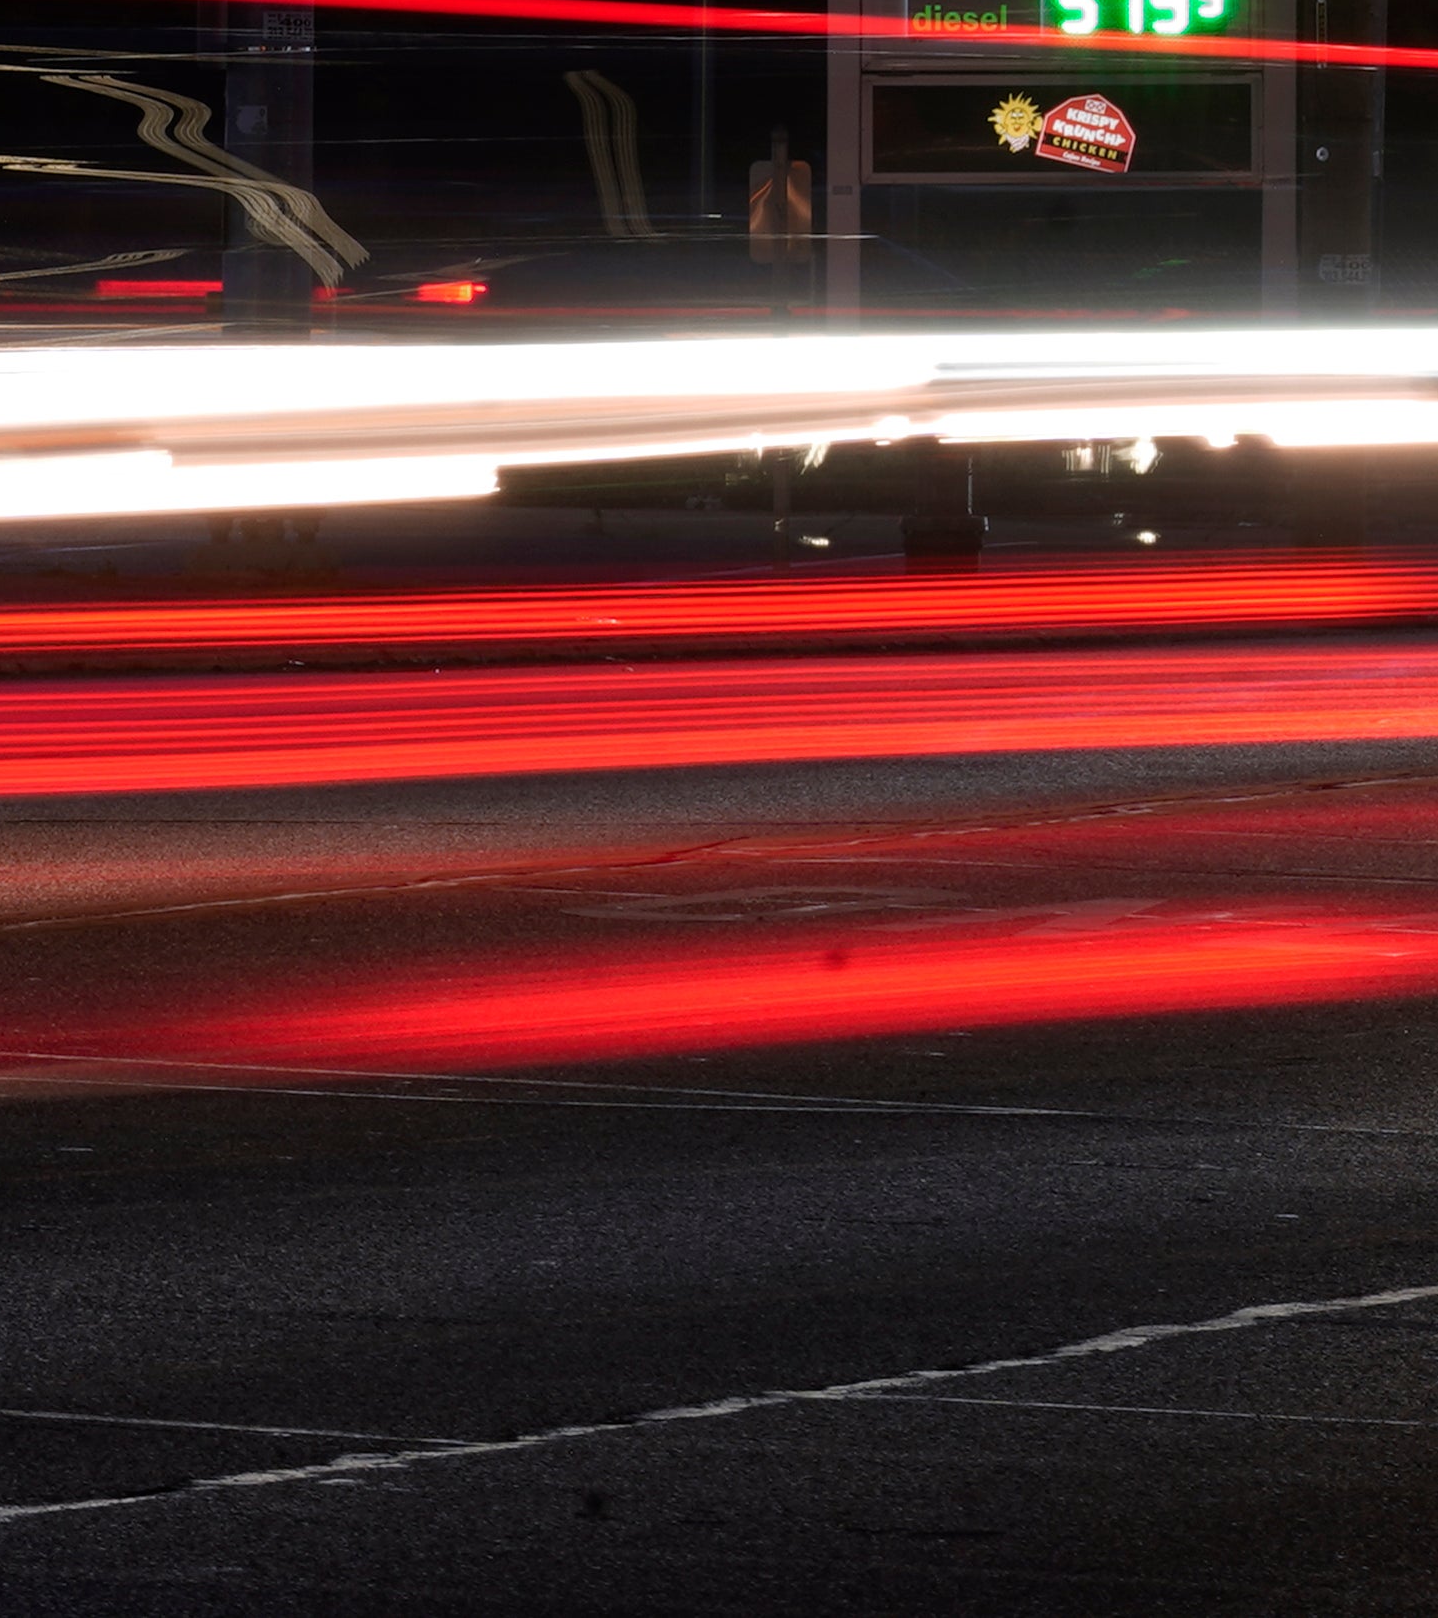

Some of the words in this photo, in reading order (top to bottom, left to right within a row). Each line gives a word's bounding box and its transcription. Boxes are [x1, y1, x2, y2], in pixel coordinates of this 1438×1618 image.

[913, 5, 1007, 31] diesel
[1066, 108, 1120, 130] KRISPY
[1052, 119, 1126, 147] KRUNCHY
[1052, 137, 1118, 159] CHICKEN
